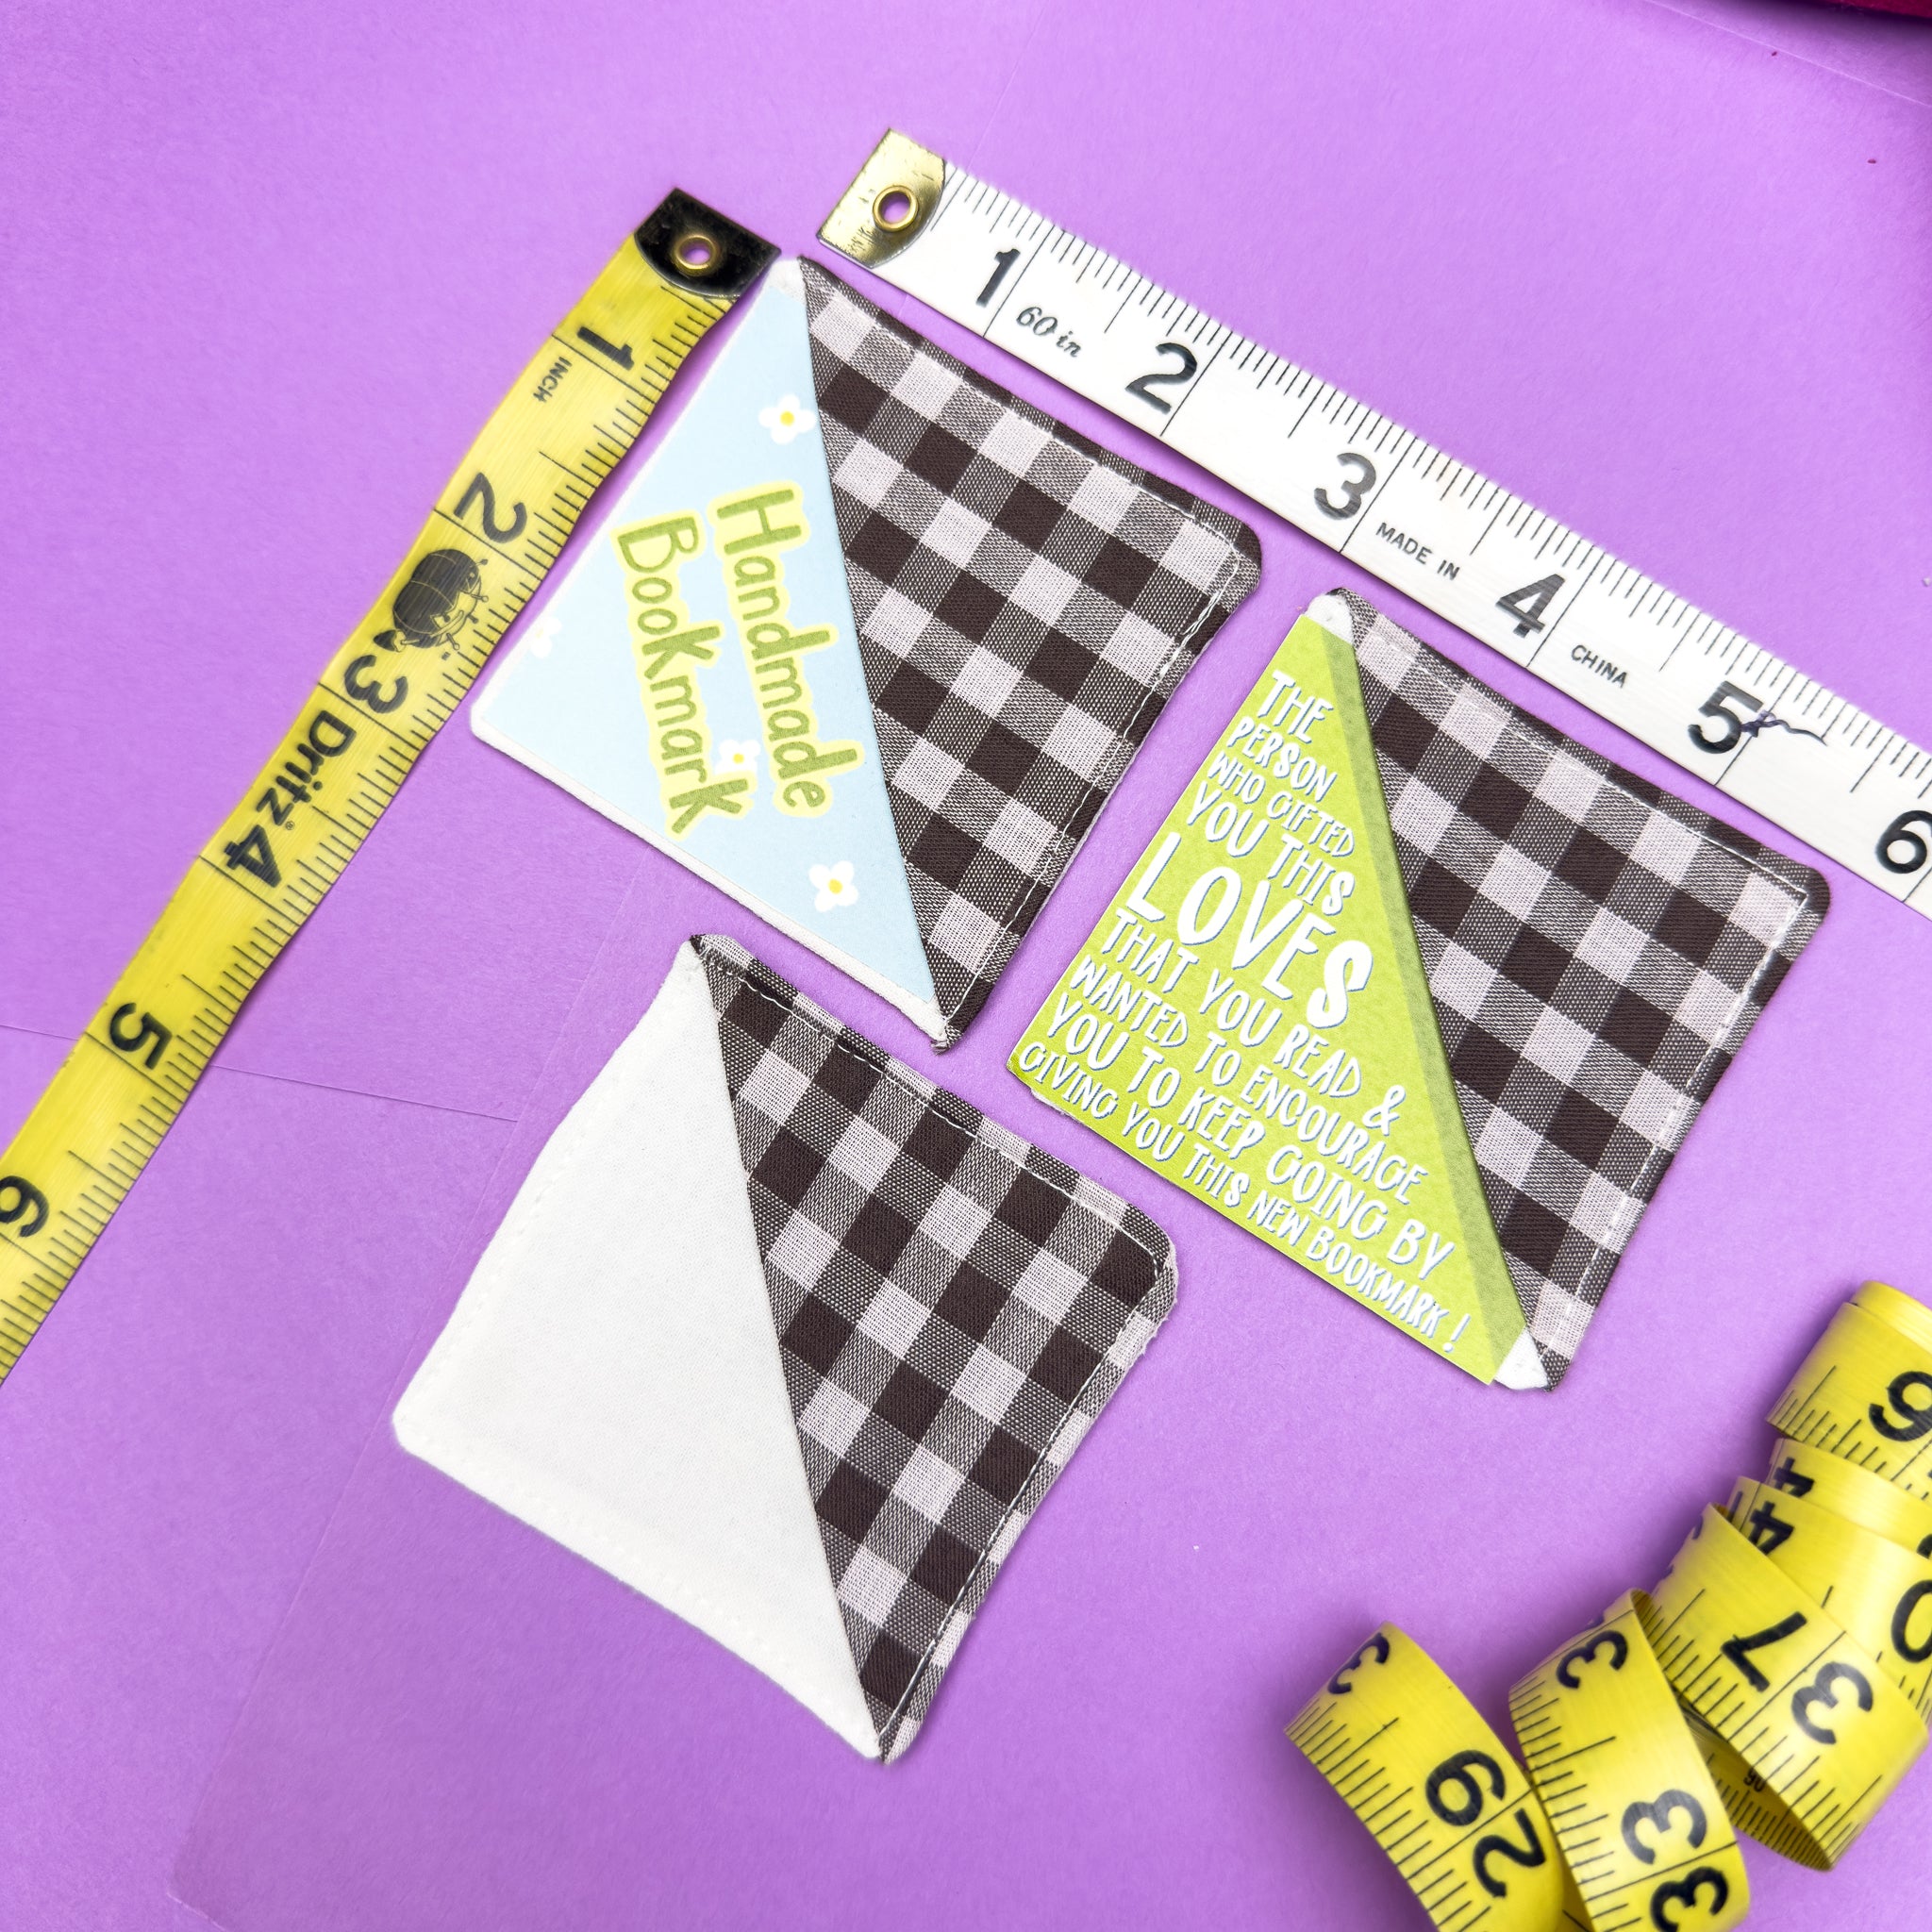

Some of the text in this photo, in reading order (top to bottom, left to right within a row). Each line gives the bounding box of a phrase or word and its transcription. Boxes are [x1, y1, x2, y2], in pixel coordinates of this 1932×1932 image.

[975, 248, 1021, 308] 1
[576, 326, 635, 371] 1
[1016, 306, 1082, 358] 60 in
[532, 357, 573, 403] INCH
[1125, 342, 1198, 414] 2
[453, 473, 527, 544] 2
[1314, 452, 1376, 520] 3
[1375, 522, 1461, 581] MADE IN
[1495, 573, 1566, 637] 4
[717, 488, 859, 809] Handmade
[1570, 643, 1629, 689] CHINA
[344, 655, 408, 715] 3
[1257, 670, 1334, 743] THE
[1688, 680, 1764, 755] 5
[1227, 716, 1337, 802] PERSON
[1207, 751, 1356, 857] WHO GIFTED
[224, 824, 282, 889] 4
[1187, 783, 1356, 916] YOU THIS
[1874, 810, 1932, 874] 6
[1125, 832, 1374, 1028] LOVES
[108, 1002, 174, 1070] 5
[1102, 908, 1406, 1136] THAT YOU READ &
[1070, 953, 1428, 1206] WANTED TO ENCOURAGE
[1046, 992, 1455, 1280] YOU TO KEEP GOING BY
[0, 1175, 49, 1238] 6
[1019, 1041, 1118, 1120] GIVING
[1121, 1101, 1185, 1162] YOU
[1183, 1142, 1251, 1208] THIS
[1248, 1191, 1317, 1246] NEW
[1306, 1226, 1450, 1340] BOOKMARK
[1868, 1371, 1932, 1441] 6
[1327, 1632, 1391, 1695] 3
[1557, 1629, 1629, 1690] 3
